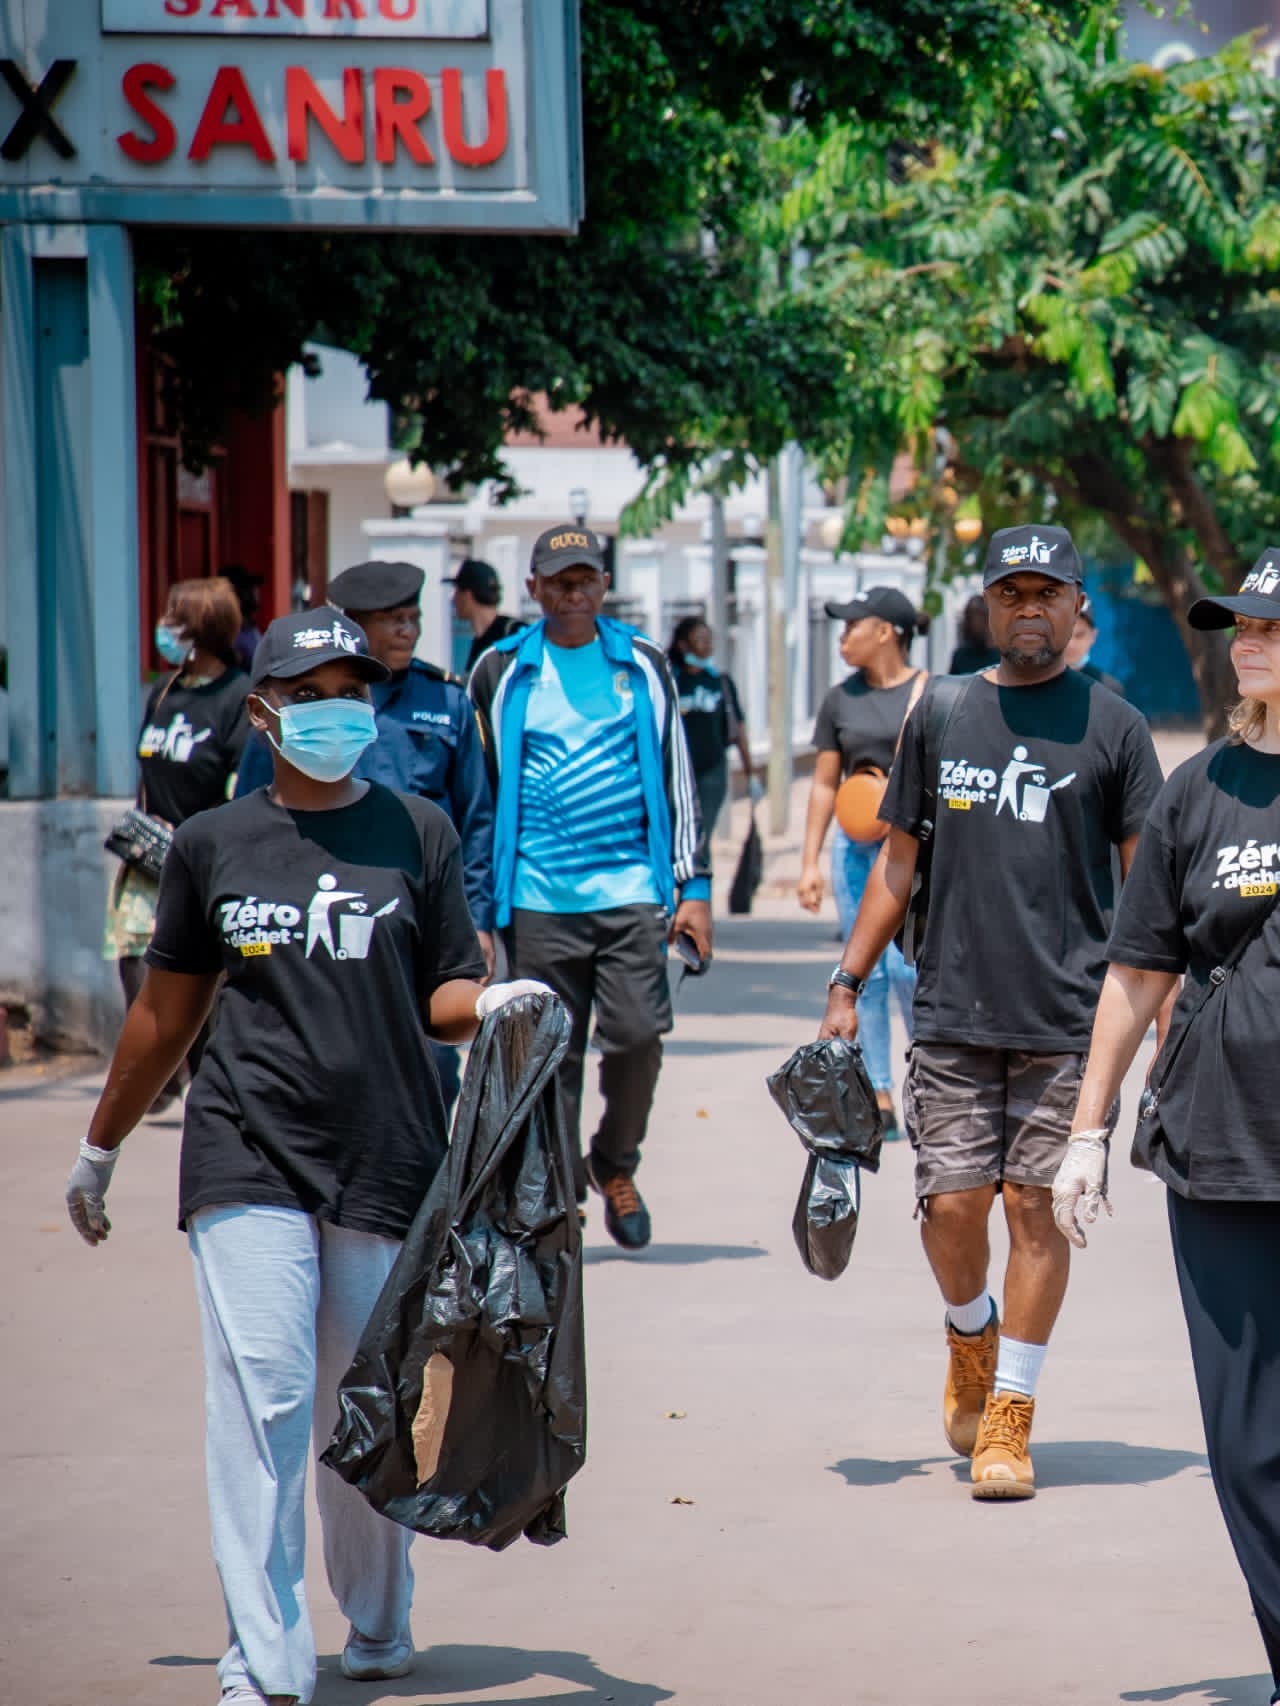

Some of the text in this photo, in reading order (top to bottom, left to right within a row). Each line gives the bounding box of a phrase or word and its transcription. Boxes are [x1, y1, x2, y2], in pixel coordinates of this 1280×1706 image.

[117, 62, 509, 168] SANRU
[940, 760, 998, 789] Zéro
[1246, 885, 1274, 895] 2024
[220, 896, 301, 933] Zéro
